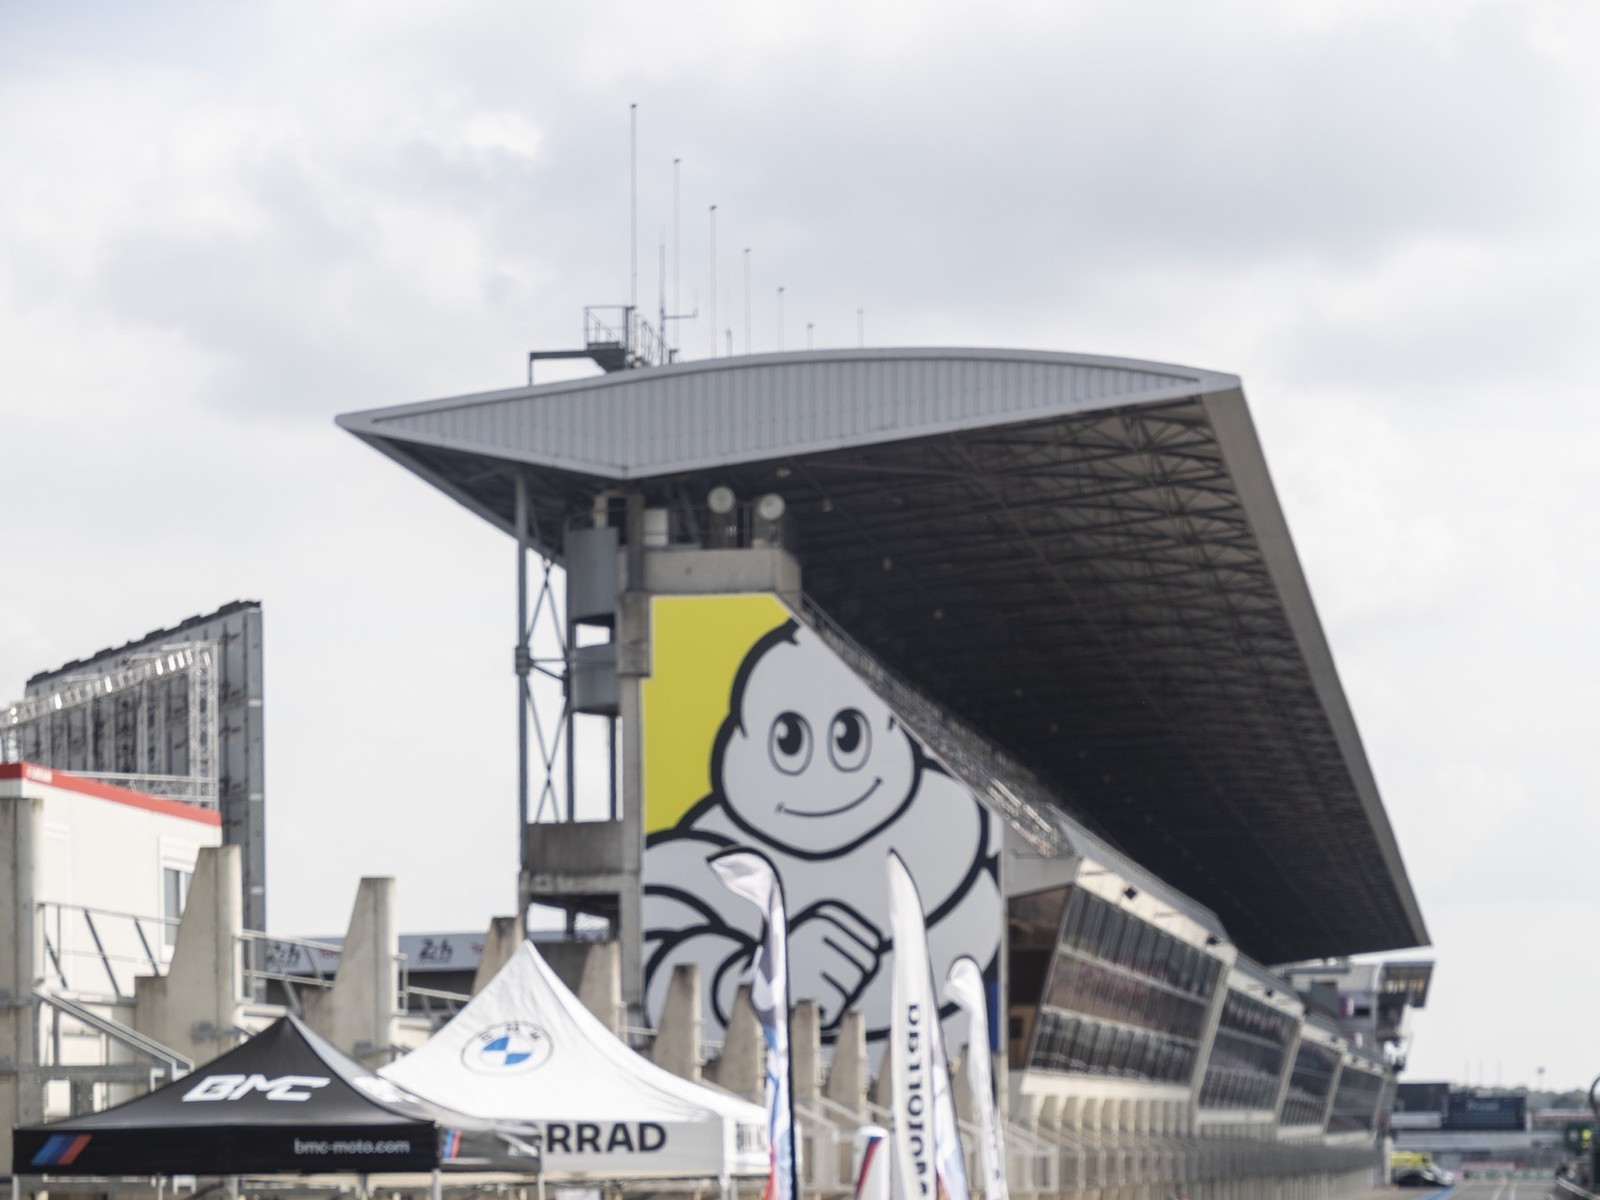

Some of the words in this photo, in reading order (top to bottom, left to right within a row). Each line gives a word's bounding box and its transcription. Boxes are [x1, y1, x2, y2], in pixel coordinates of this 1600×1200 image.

[182, 1073, 332, 1102] BMC
[294, 1138, 411, 1155] bmc-moto.com
[545, 1121, 668, 1154] RRAD
